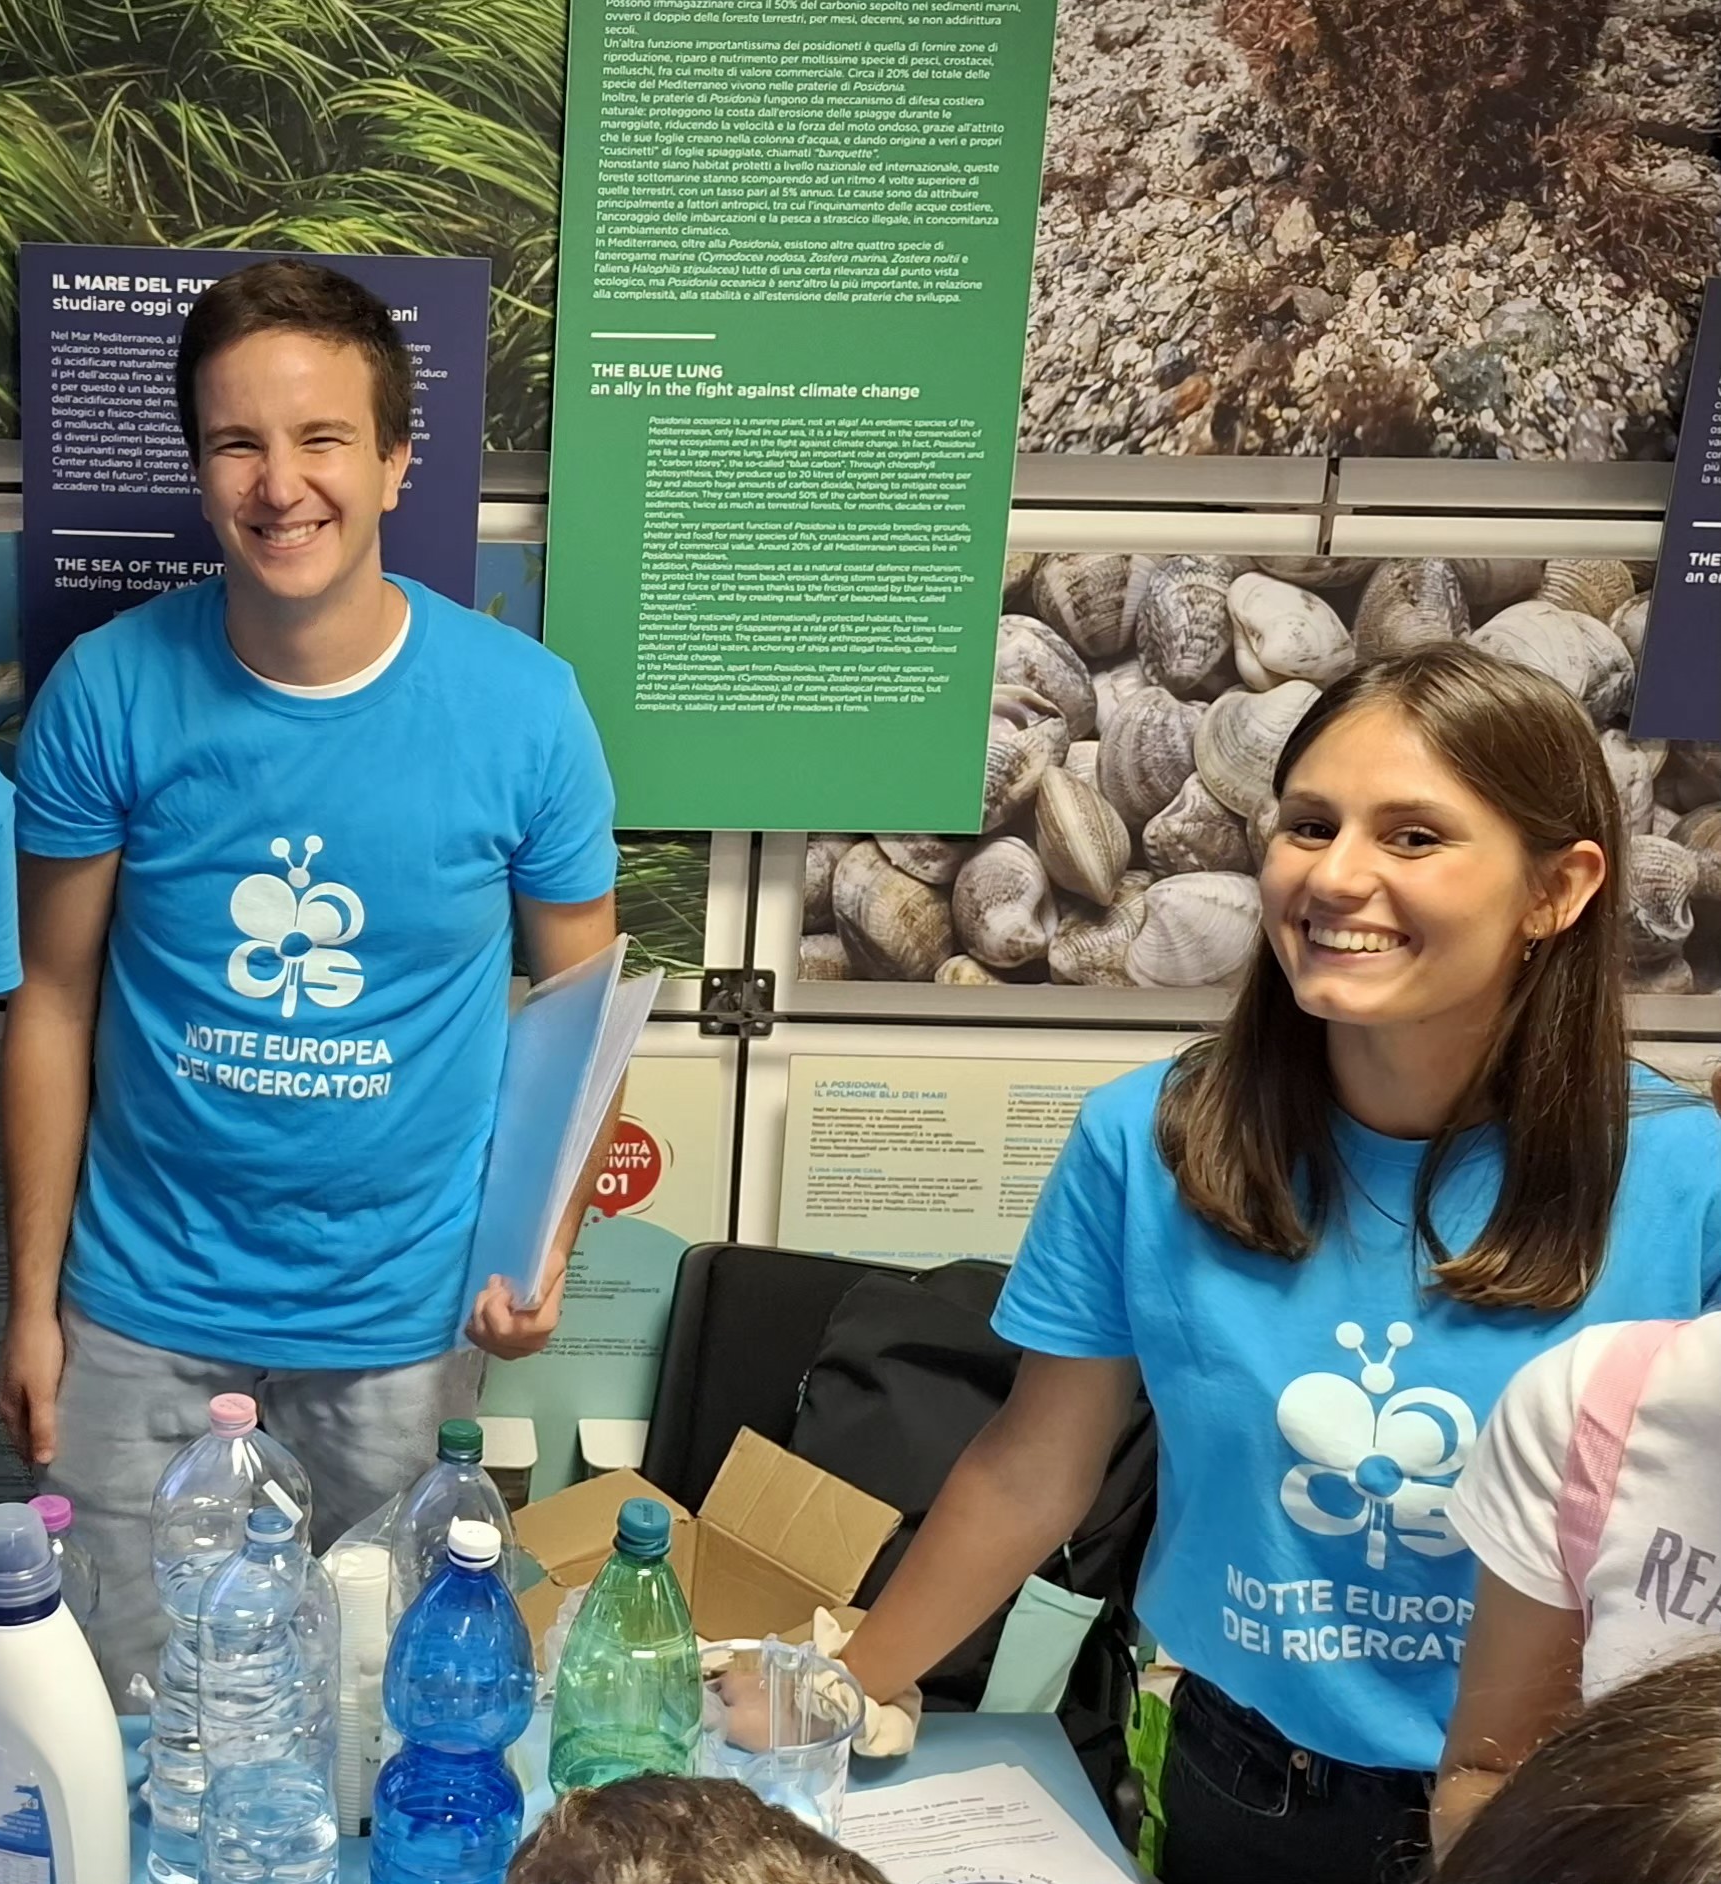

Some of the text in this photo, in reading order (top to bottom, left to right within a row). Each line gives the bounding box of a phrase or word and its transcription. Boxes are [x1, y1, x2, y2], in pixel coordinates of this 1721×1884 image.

[605, 13, 641, 22] ovvero
[652, 11, 691, 24] doppio
[693, 12, 719, 22] delle
[722, 12, 759, 23] foreste
[809, 15, 828, 25] per
[907, 16, 919, 24] se
[922, 16, 942, 24] non
[945, 14, 1002, 25] addirittura
[658, 65, 672, 76] fra
[674, 66, 691, 76] cui
[693, 66, 724, 77] molte
[726, 66, 737, 77] di
[739, 66, 772, 77] valore
[847, 67, 874, 78] Circa
[885, 68, 909, 78] 20%
[911, 68, 928, 79] del
[931, 68, 962, 79] totale
[964, 68, 991, 79] delle
[52, 274, 220, 295] IL MARE DEL FUT
[52, 296, 126, 312] studiare
[130, 299, 172, 317] oggi
[387, 307, 419, 322] ani
[51, 329, 68, 341] Nel
[71, 330, 90, 341] Mar
[166, 333, 176, 344] al
[51, 342, 100, 354] vulcanico
[102, 344, 166, 356] sottomarino
[51, 355, 178, 370] di acidificare naturalmen
[59, 368, 75, 381] pH
[77, 369, 129, 383] dell'acqua
[131, 370, 152, 382] fino
[153, 371, 164, 382] ai
[415, 367, 448, 378] riduce
[592, 363, 723, 378] THE BLUE LUNG
[60, 383, 78, 394] per
[80, 382, 116, 395] questo
[127, 385, 141, 394] un
[143, 383, 176, 395] labora
[590, 380, 920, 401] an ally in the fight against climate change
[51, 394, 142, 407] dell'acidificazione
[144, 396, 161, 407] del
[51, 406, 95, 420] biologici
[97, 409, 105, 418] e
[52, 418, 61, 429] di
[117, 420, 135, 431] alla
[137, 421, 182, 433] calcifica
[52, 431, 186, 447] di diversi polimeri bioplast
[52, 443, 62, 454] di
[64, 443, 114, 457] inquinanti
[117, 445, 142, 458] negli
[52, 455, 86, 467] Center
[88, 456, 133, 468] studiano
[143, 458, 179, 470] cratere
[181, 461, 189, 470] e
[64, 471, 91, 480] mare
[93, 469, 109, 480] del
[152, 471, 188, 484] perché
[52, 481, 190, 495] accadere tra alcuni decenni
[54, 557, 226, 576] THE SEA OF THE FUT
[1689, 553, 1721, 566] THE
[55, 576, 122, 592] studying
[126, 578, 171, 593] today
[1685, 572, 1704, 583] an
[185, 1022, 392, 1066] NOTTE EUROPEA
[176, 1053, 391, 1099] DEI RICERCATORI
[815, 1081, 828, 1089] LA
[826, 1090, 876, 1098] POLMONE
[879, 1091, 899, 1099] BLU
[902, 1091, 919, 1099] DEI
[922, 1091, 947, 1099] MARI
[609, 1140, 651, 1155] IVITÀ
[608, 1156, 652, 1169] IVITY
[596, 1173, 628, 1195] 01
[1227, 1564, 1475, 1627] NOTTE EUROP
[1223, 1606, 1467, 1662] DEI RICERCAT
